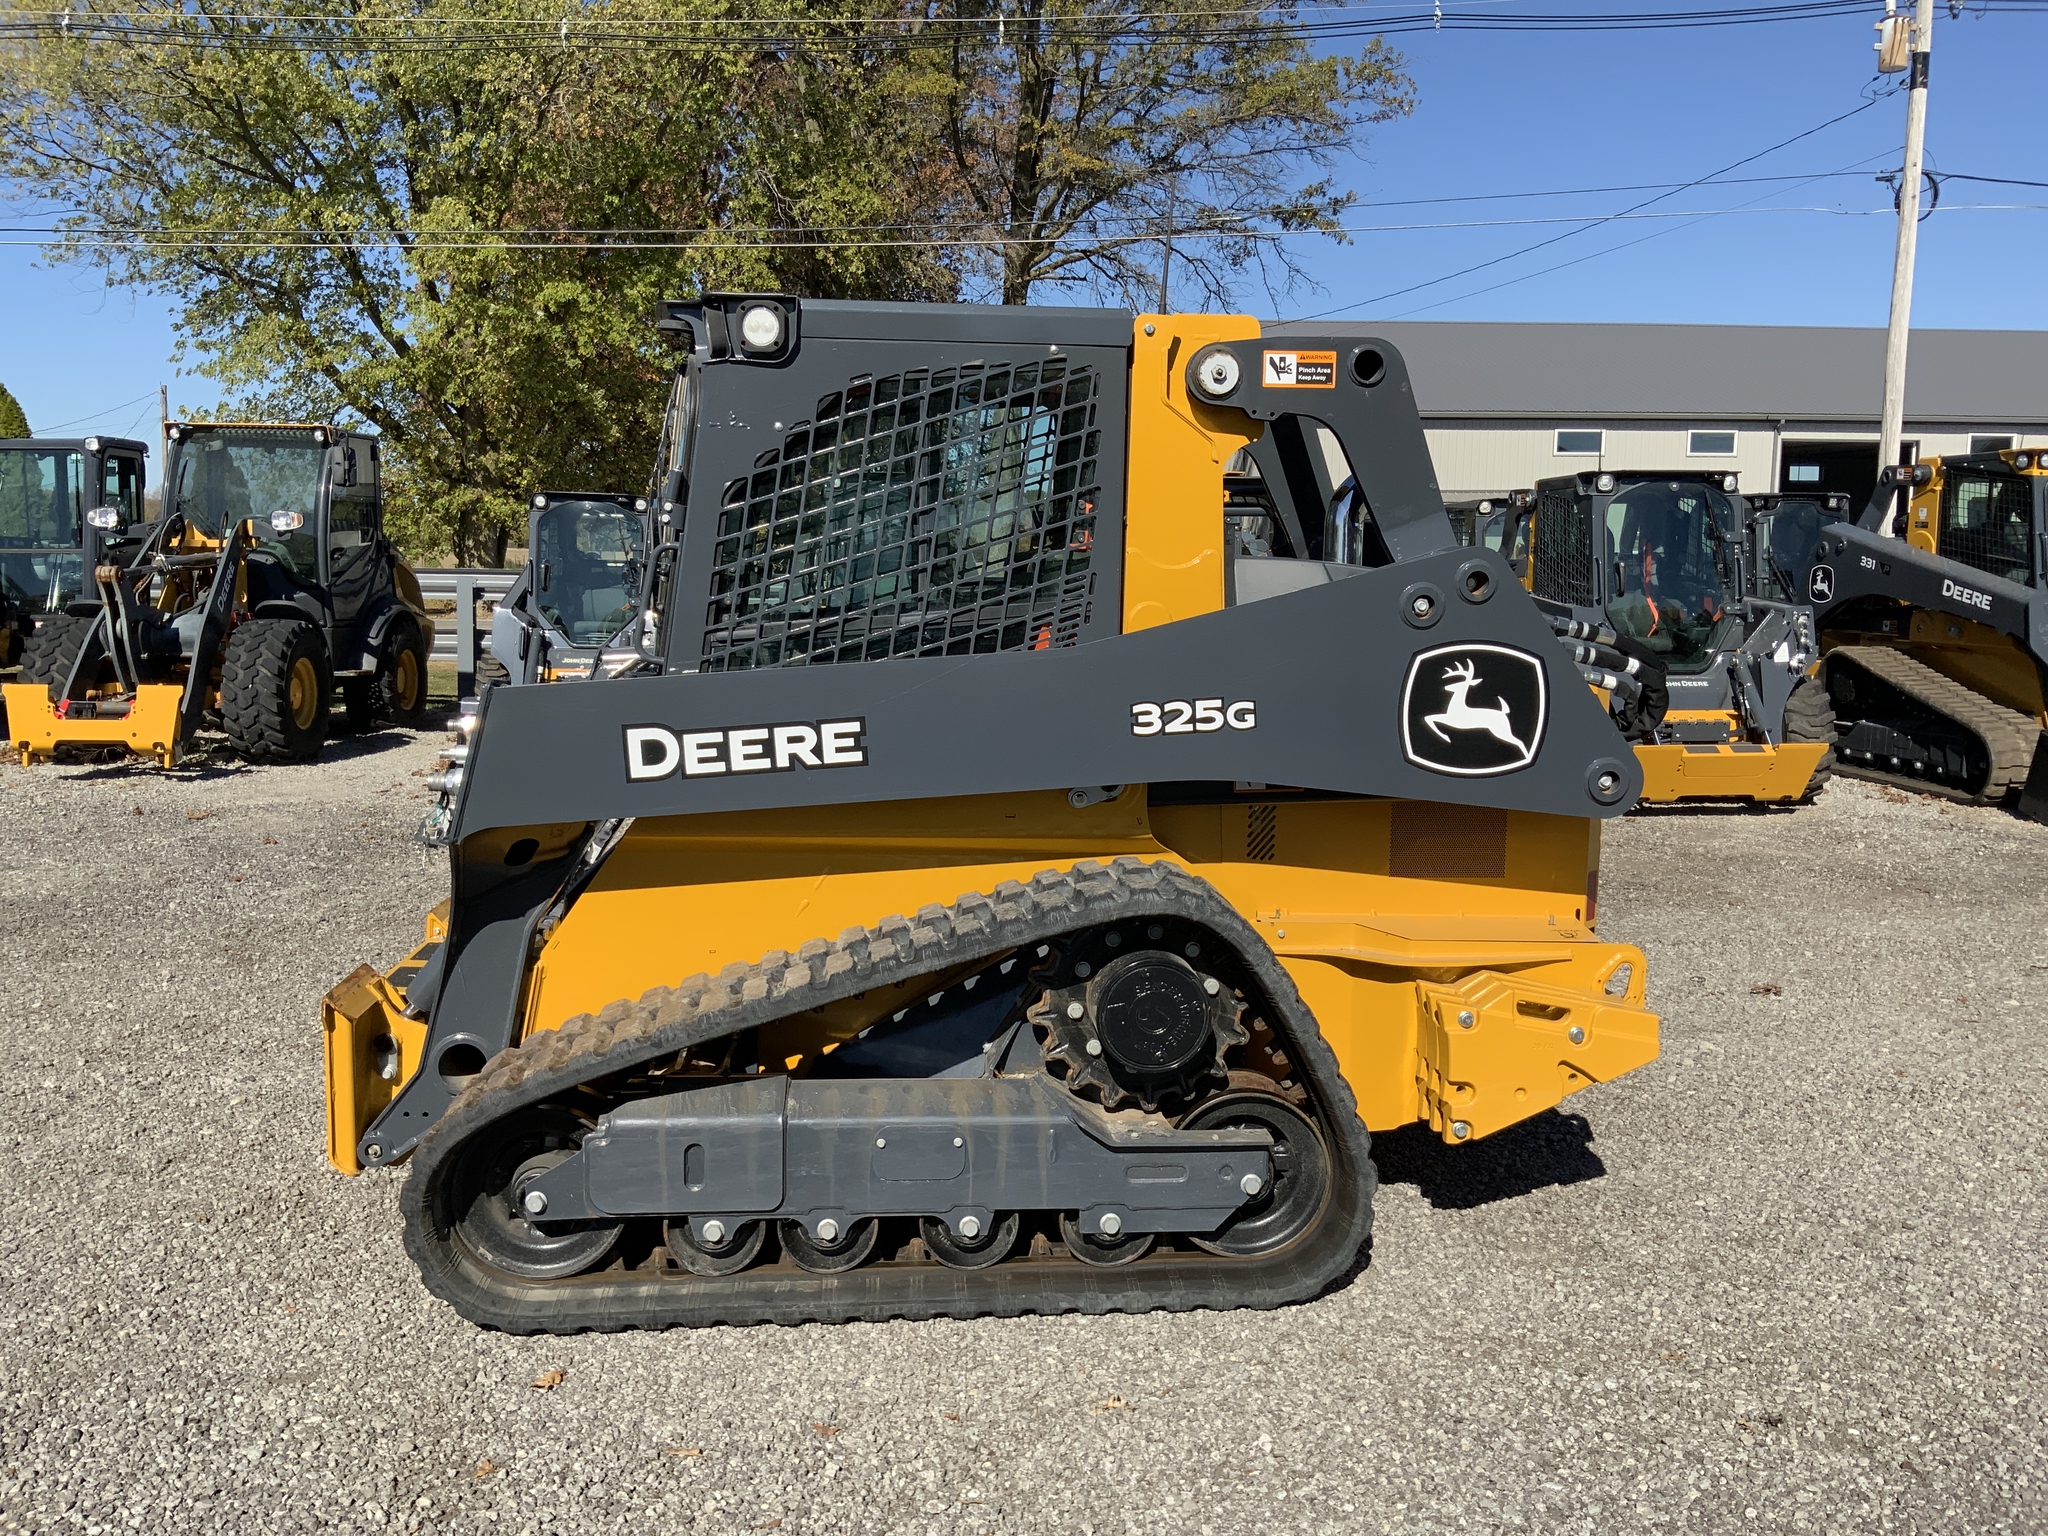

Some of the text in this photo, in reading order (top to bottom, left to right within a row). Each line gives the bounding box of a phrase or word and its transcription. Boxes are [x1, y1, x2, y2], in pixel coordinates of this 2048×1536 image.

[1860, 555, 1876, 570] 331
[217, 561, 235, 613] DEERE
[1942, 579, 1993, 611] DEERE
[1131, 700, 1257, 736] 325G
[626, 721, 864, 780] DEERE
